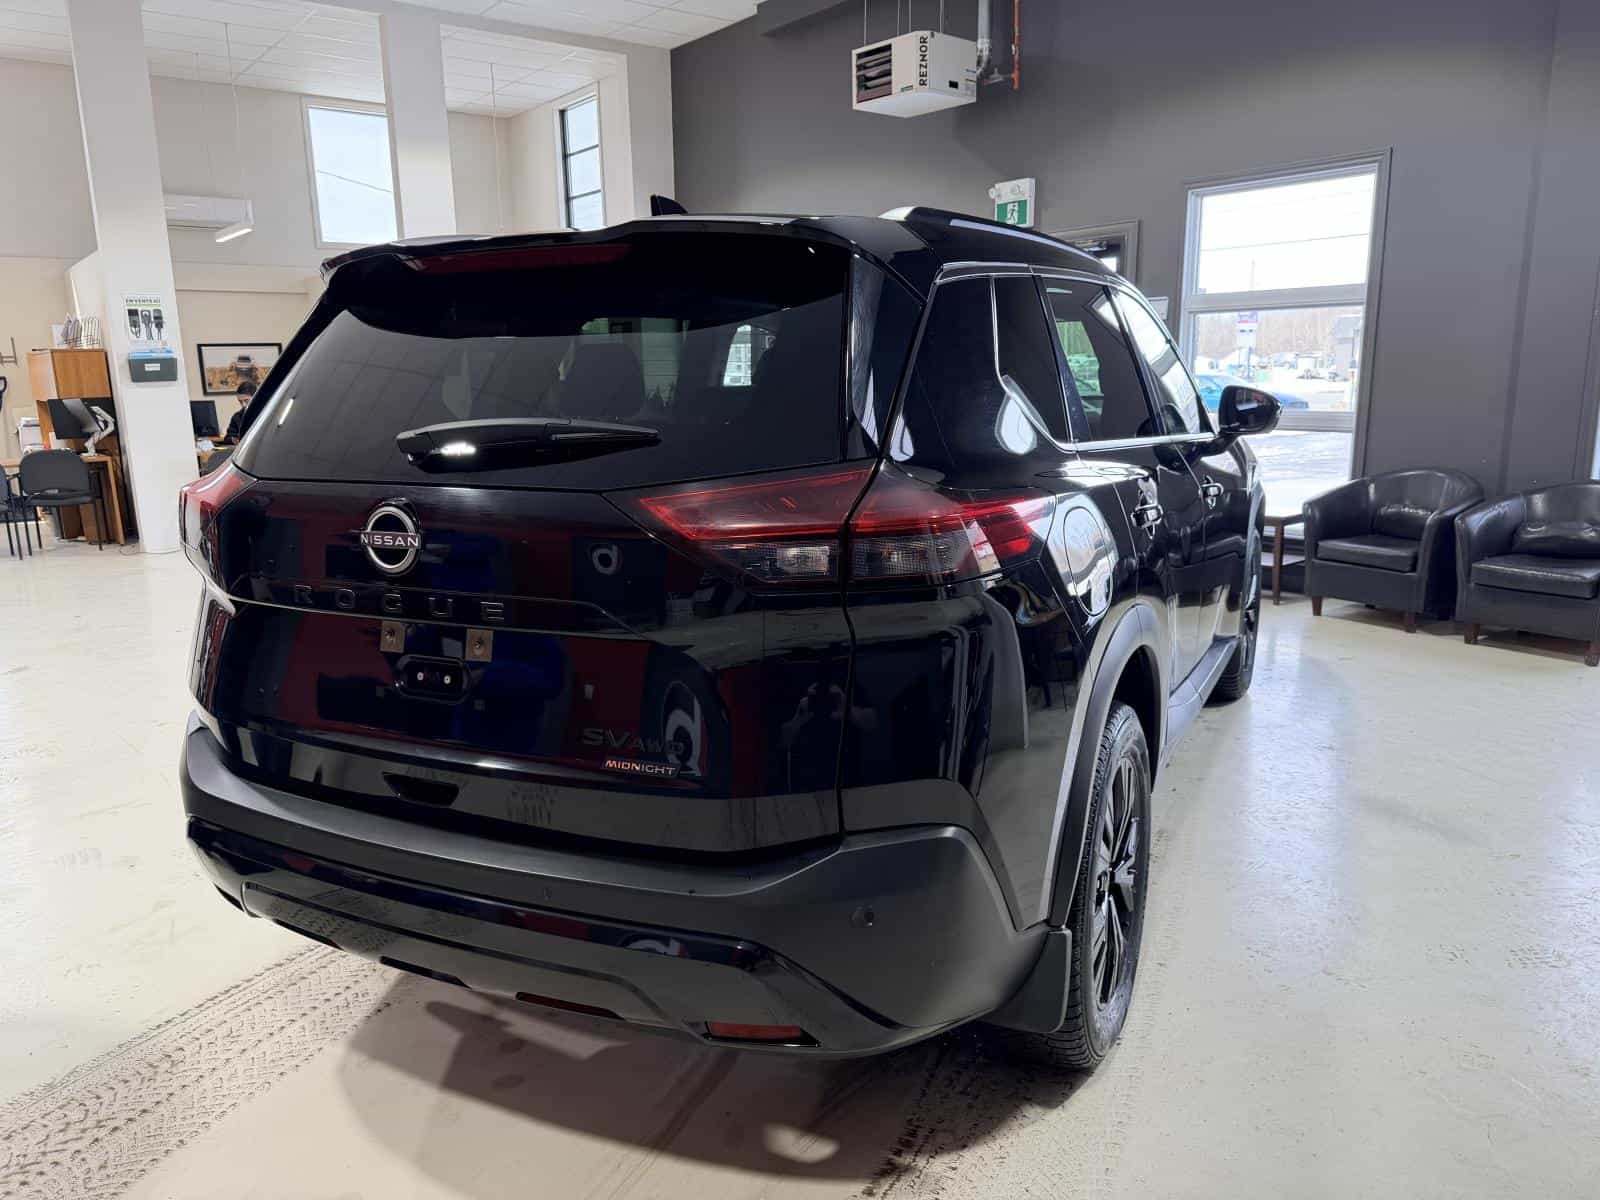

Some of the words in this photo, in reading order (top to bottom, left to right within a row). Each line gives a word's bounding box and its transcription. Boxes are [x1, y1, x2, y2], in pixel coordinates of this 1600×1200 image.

[919, 36, 928, 86] REZNOR
[360, 534, 418, 547] NISSAN
[294, 584, 504, 622] ROGUE
[583, 727, 631, 747] SV
[604, 759, 677, 775] MIDNIGHT
